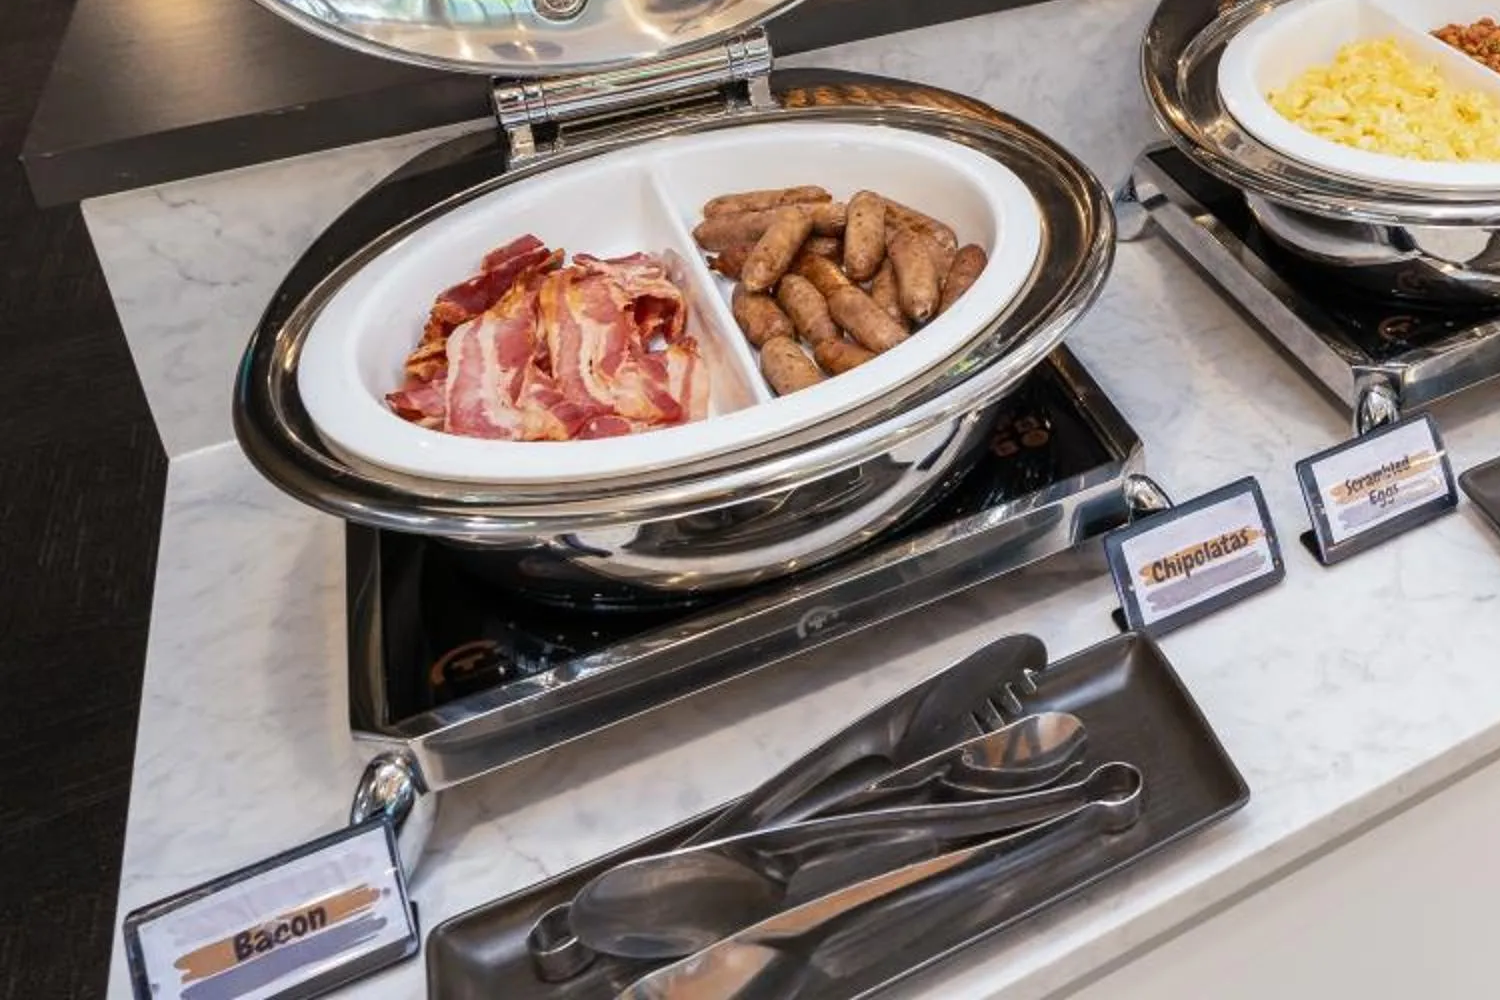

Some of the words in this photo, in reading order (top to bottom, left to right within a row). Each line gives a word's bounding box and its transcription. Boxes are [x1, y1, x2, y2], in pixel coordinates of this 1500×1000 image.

[1345, 455, 1411, 496] Scrambled
[1369, 483, 1399, 508] Eggs
[1151, 526, 1250, 583] Chipolatas
[232, 906, 327, 962] Bacon
